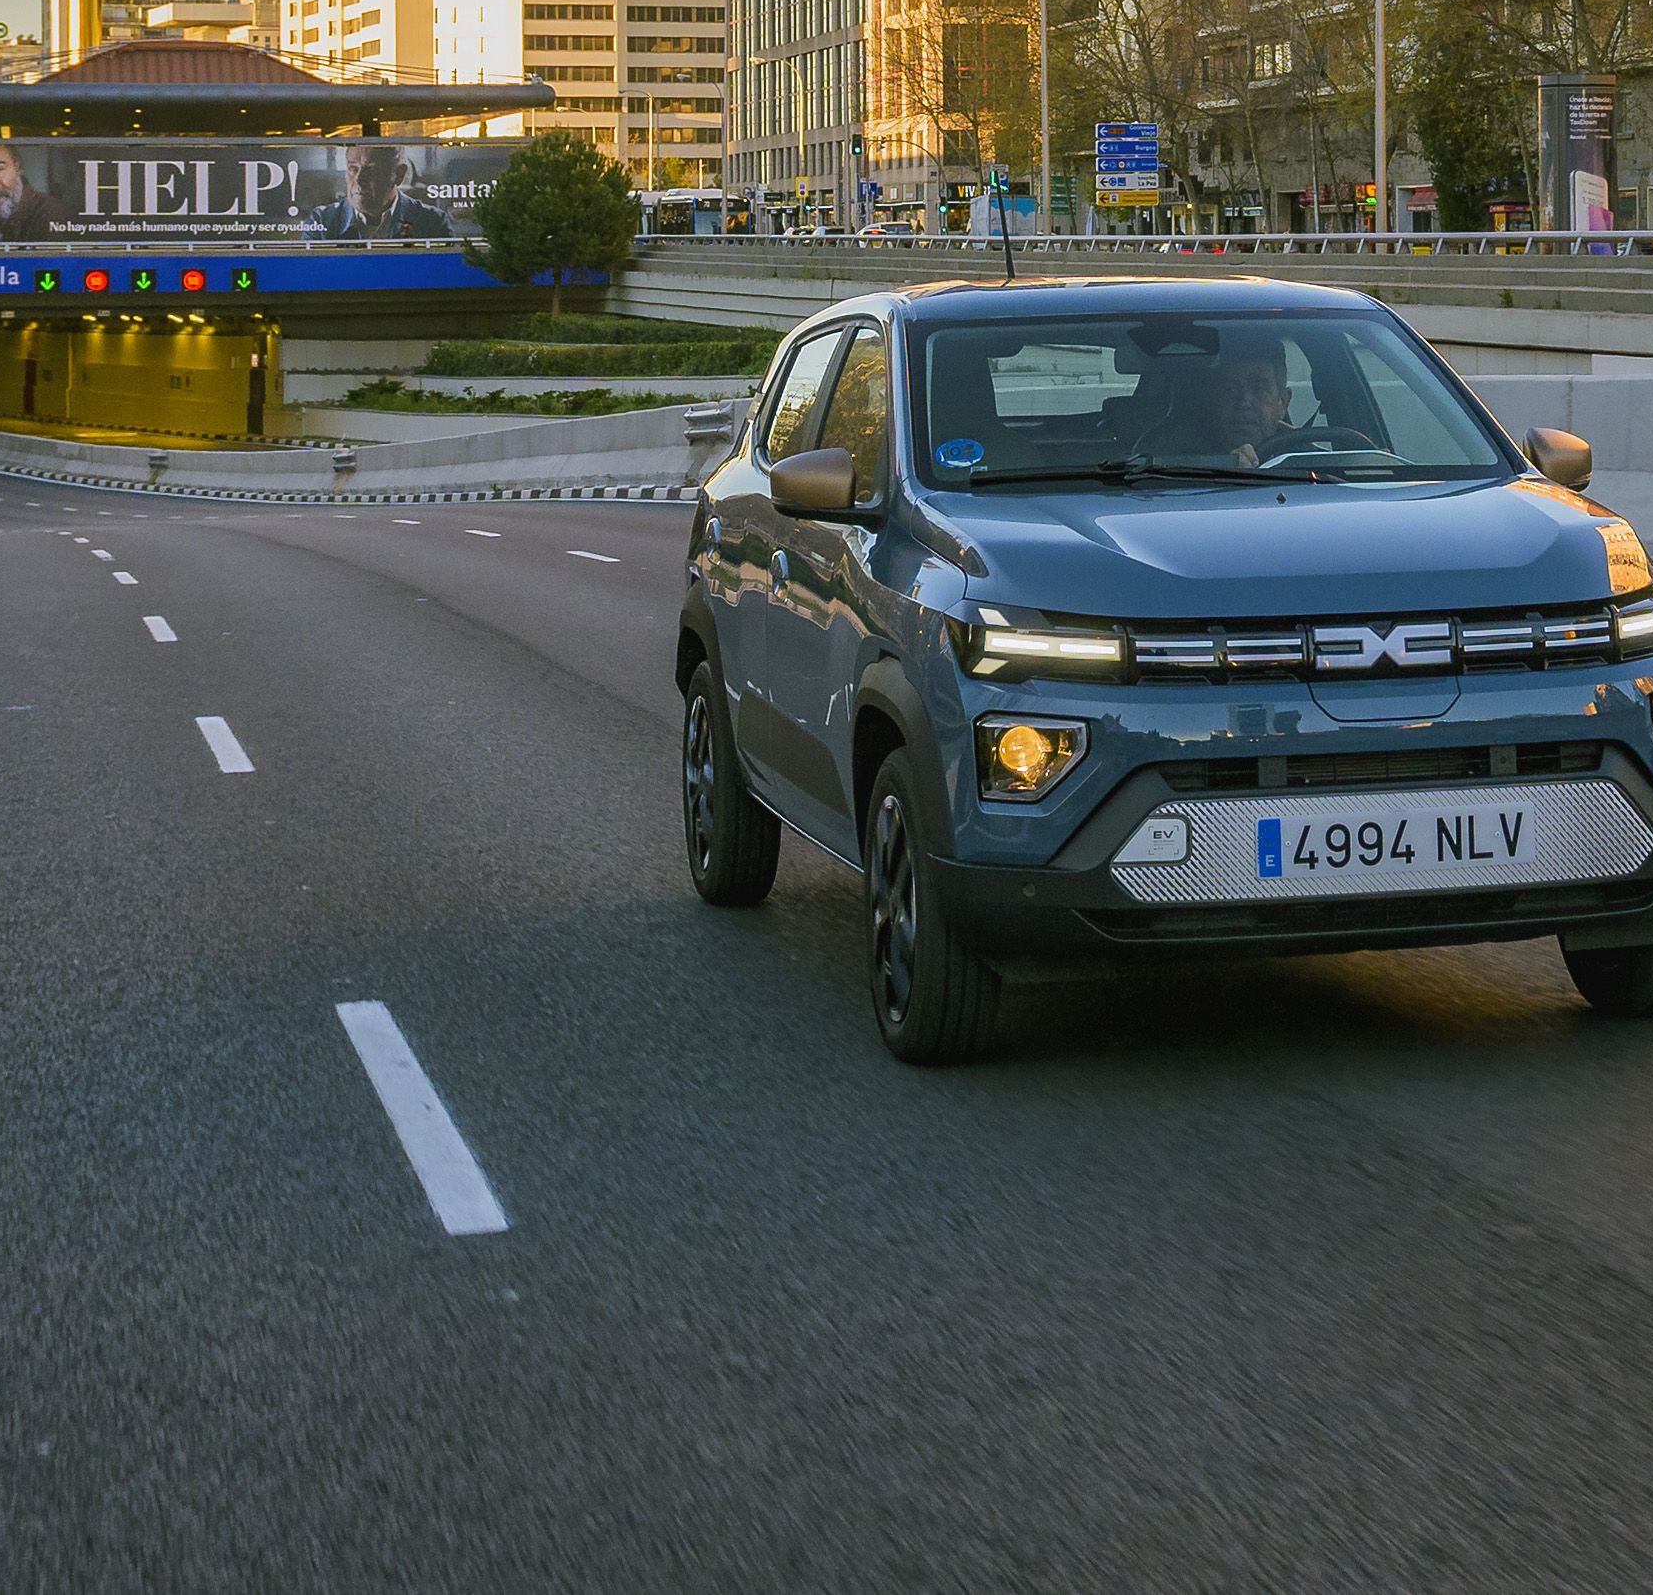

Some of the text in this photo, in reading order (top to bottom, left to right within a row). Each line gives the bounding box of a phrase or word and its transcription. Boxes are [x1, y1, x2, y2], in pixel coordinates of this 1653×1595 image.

[78, 160, 299, 217] HELP!
[427, 180, 497, 198] santa
[49, 221, 328, 235] No hay nada más humano que ayudar y ser ayudado.
[1153, 830, 1174, 839] EV
[1293, 812, 1523, 870] 4994 NLV
[1265, 855, 1275, 867] E
